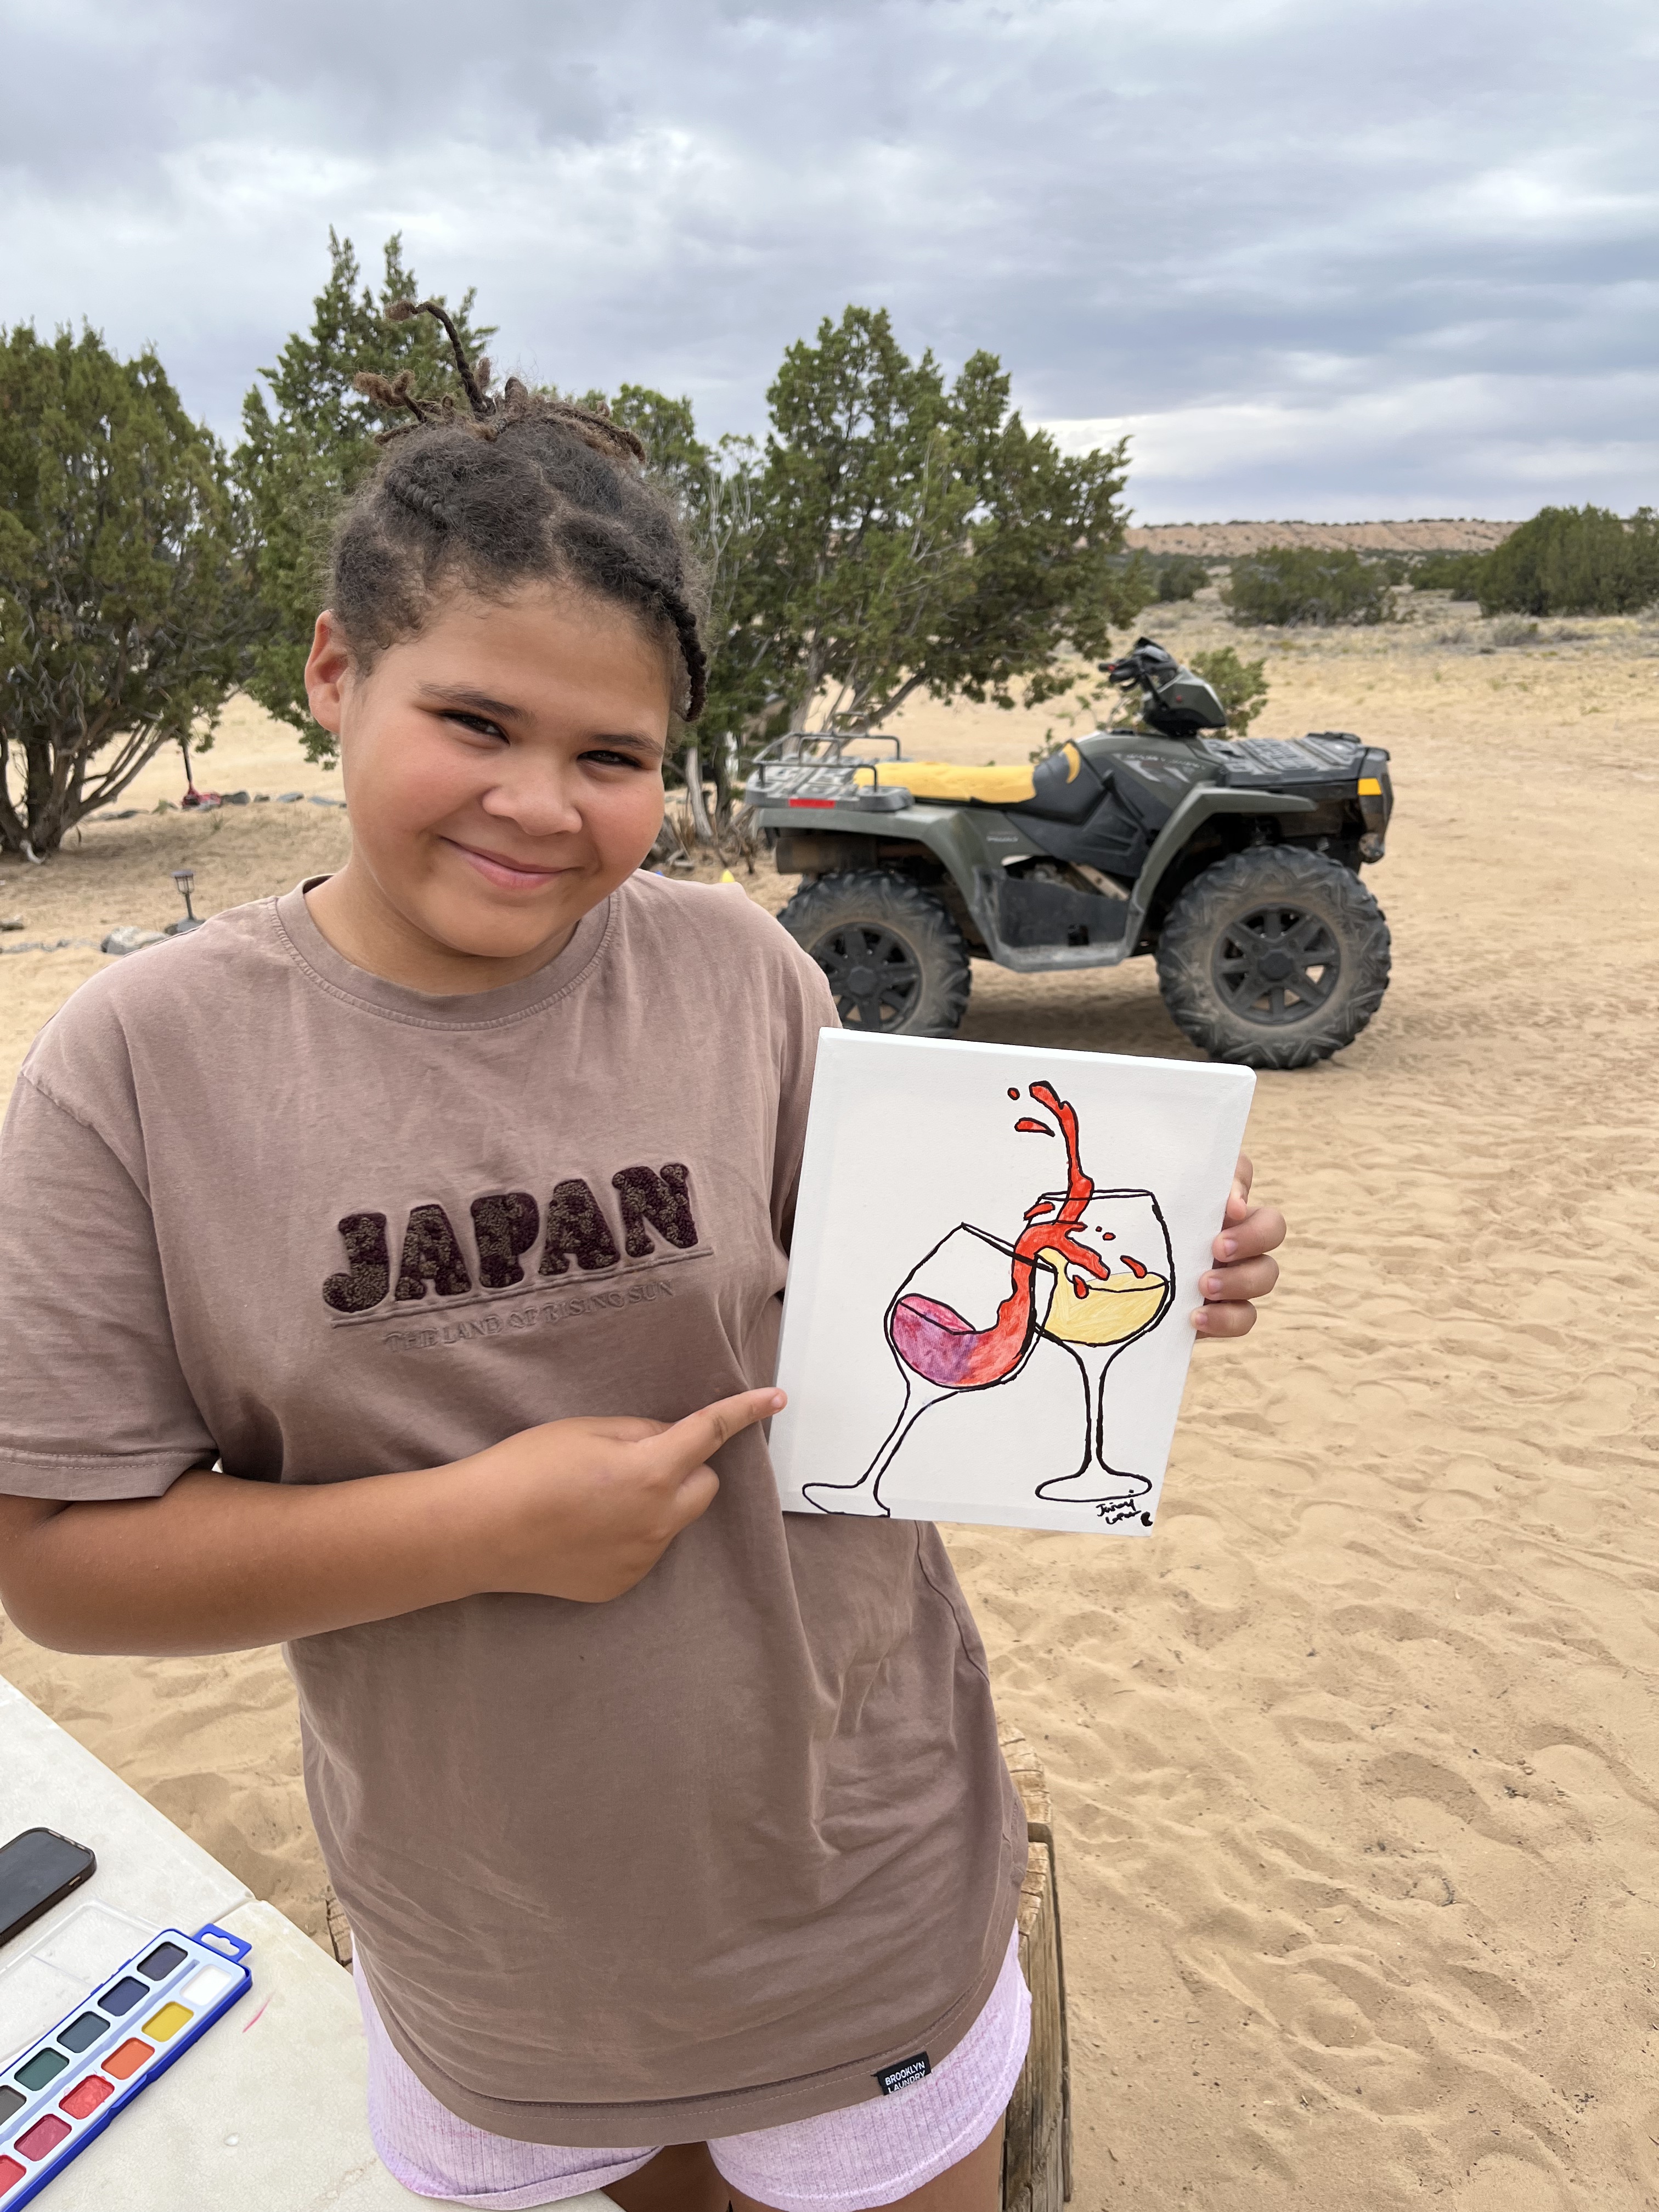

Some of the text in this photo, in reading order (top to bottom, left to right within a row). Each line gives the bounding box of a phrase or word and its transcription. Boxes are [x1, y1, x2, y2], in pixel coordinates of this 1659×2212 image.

[323, 1163, 698, 1313] JAPAN
[383, 1280, 675, 1351] THE LAND OF RISING SUN
[885, 2061, 926, 2086] BROOKLYN
[888, 2070, 926, 2093] LAUNDRY
